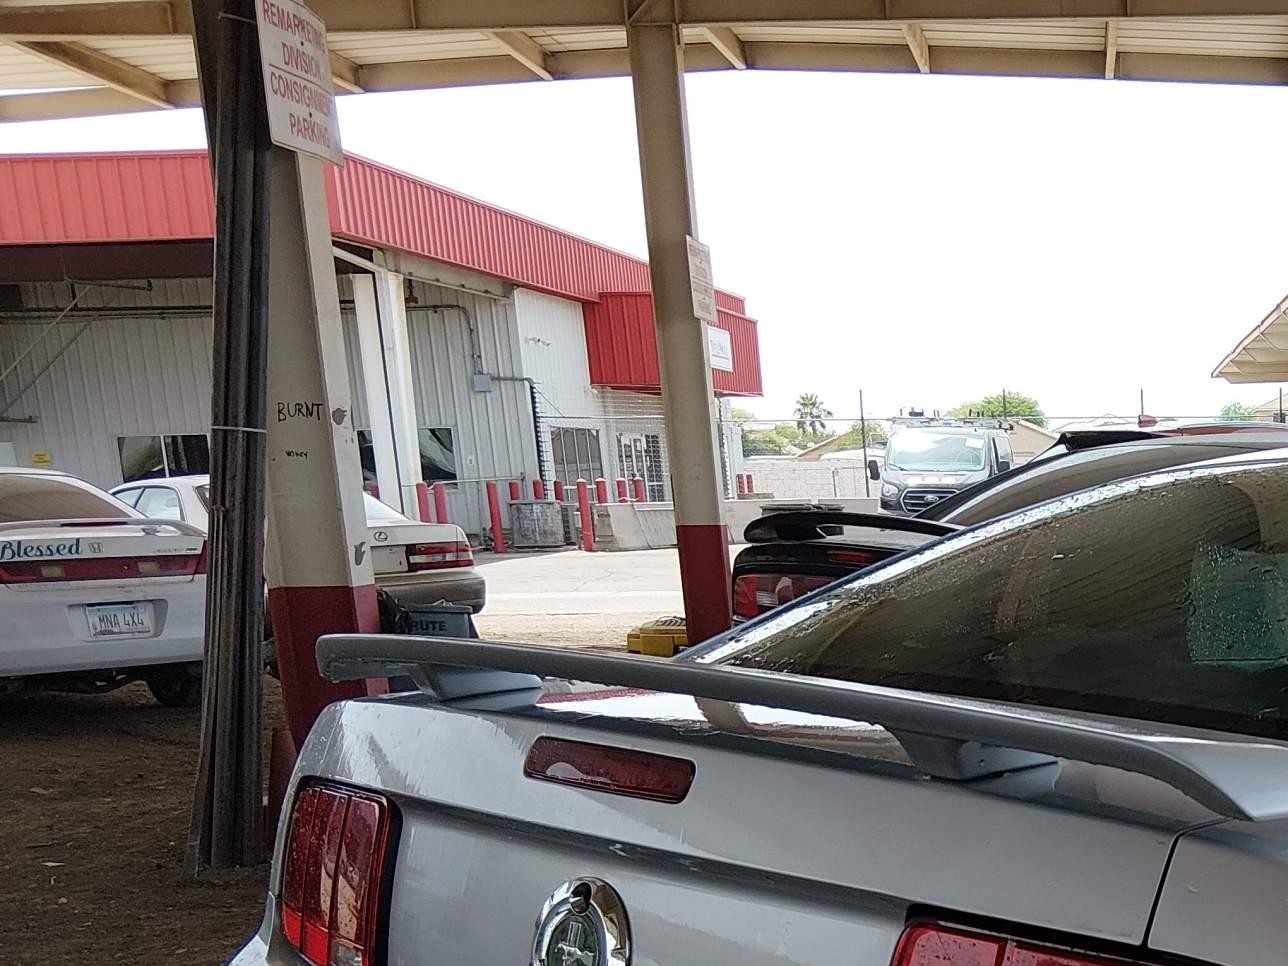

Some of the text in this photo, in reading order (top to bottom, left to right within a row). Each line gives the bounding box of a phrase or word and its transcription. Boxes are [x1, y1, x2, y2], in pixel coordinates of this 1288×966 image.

[262, 0, 325, 53] REMARKETING
[282, 42, 321, 80] DIVISION
[289, 112, 330, 149] PARKING
[277, 401, 324, 422] BURNT
[0, 538, 81, 560] Blessed
[98, 612, 145, 629] MNA 4X4
[409, 620, 449, 632] RUTE
